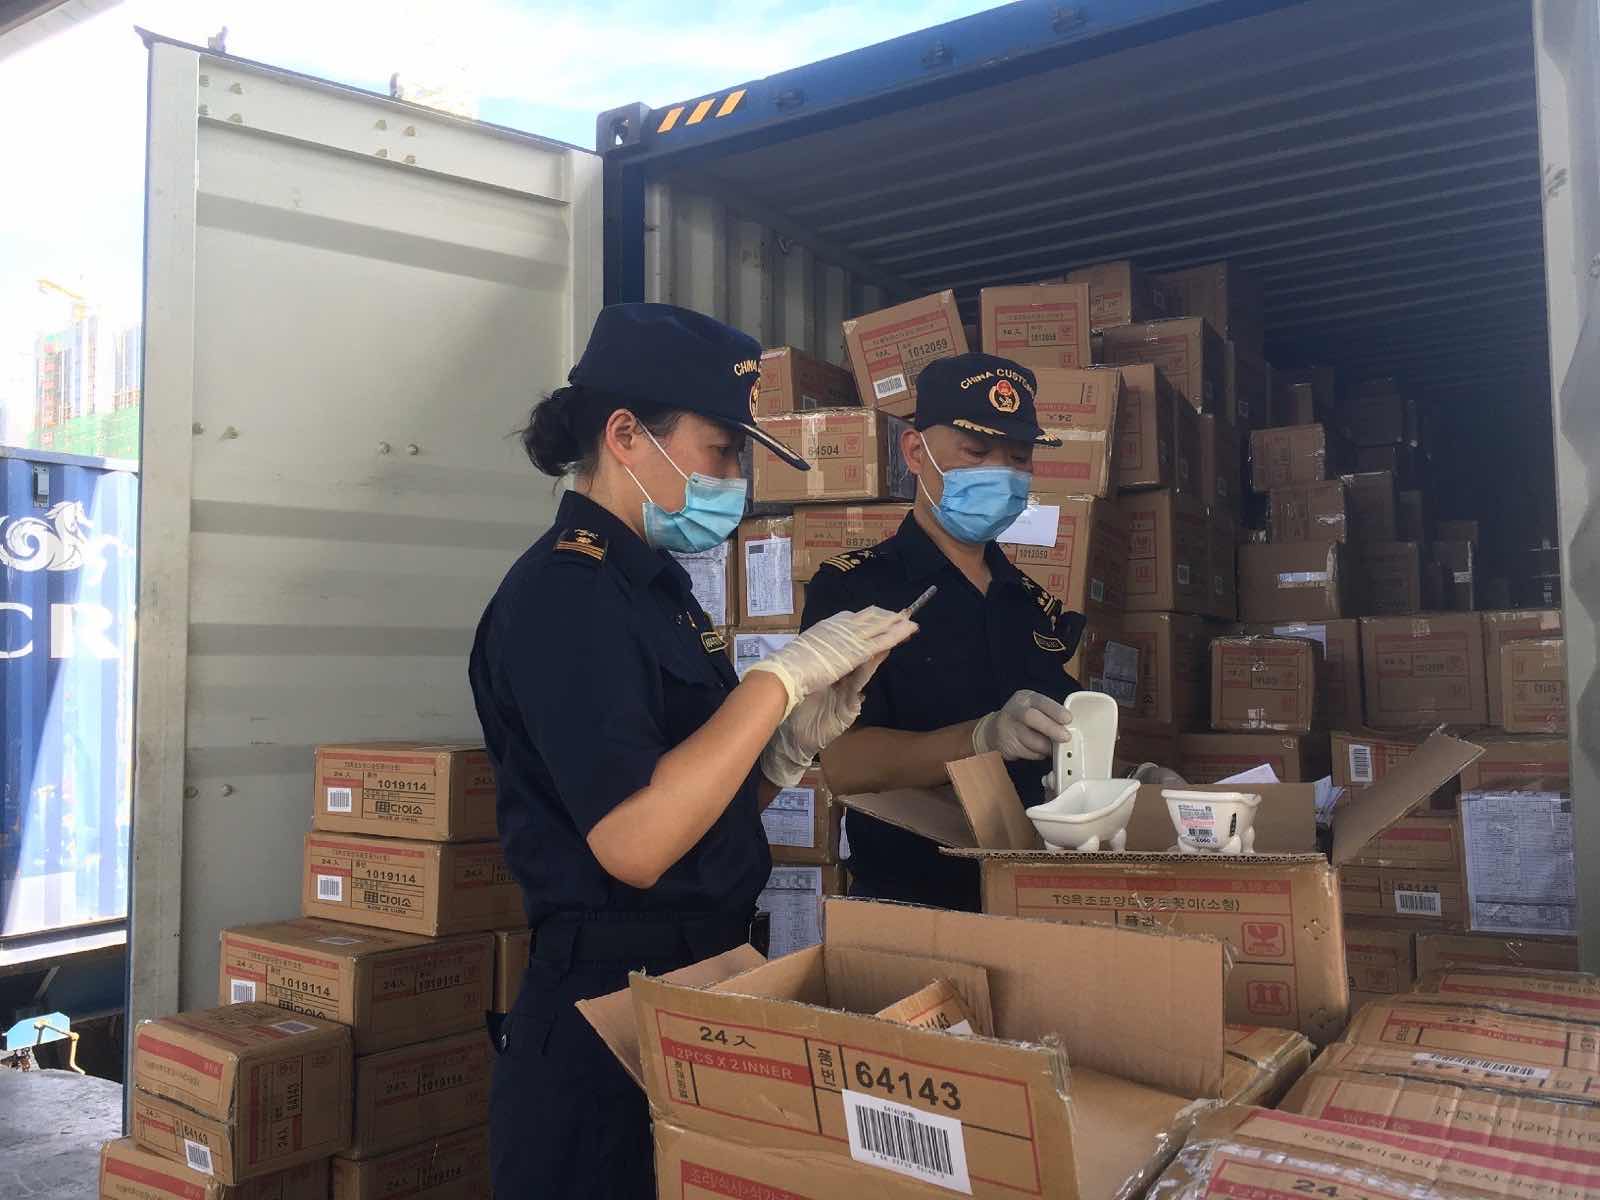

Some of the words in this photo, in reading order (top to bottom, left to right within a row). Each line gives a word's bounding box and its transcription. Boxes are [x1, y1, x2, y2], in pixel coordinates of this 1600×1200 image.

[733, 359, 757, 377] CHINA
[960, 371, 994, 390] CHINA
[377, 779, 428, 791] 1019114
[366, 869, 416, 884] 1019114
[280, 976, 331, 997] 1019114
[672, 1045, 715, 1065] 12PCS
[742, 1060, 794, 1081] INNER
[855, 1060, 963, 1111] 64143
